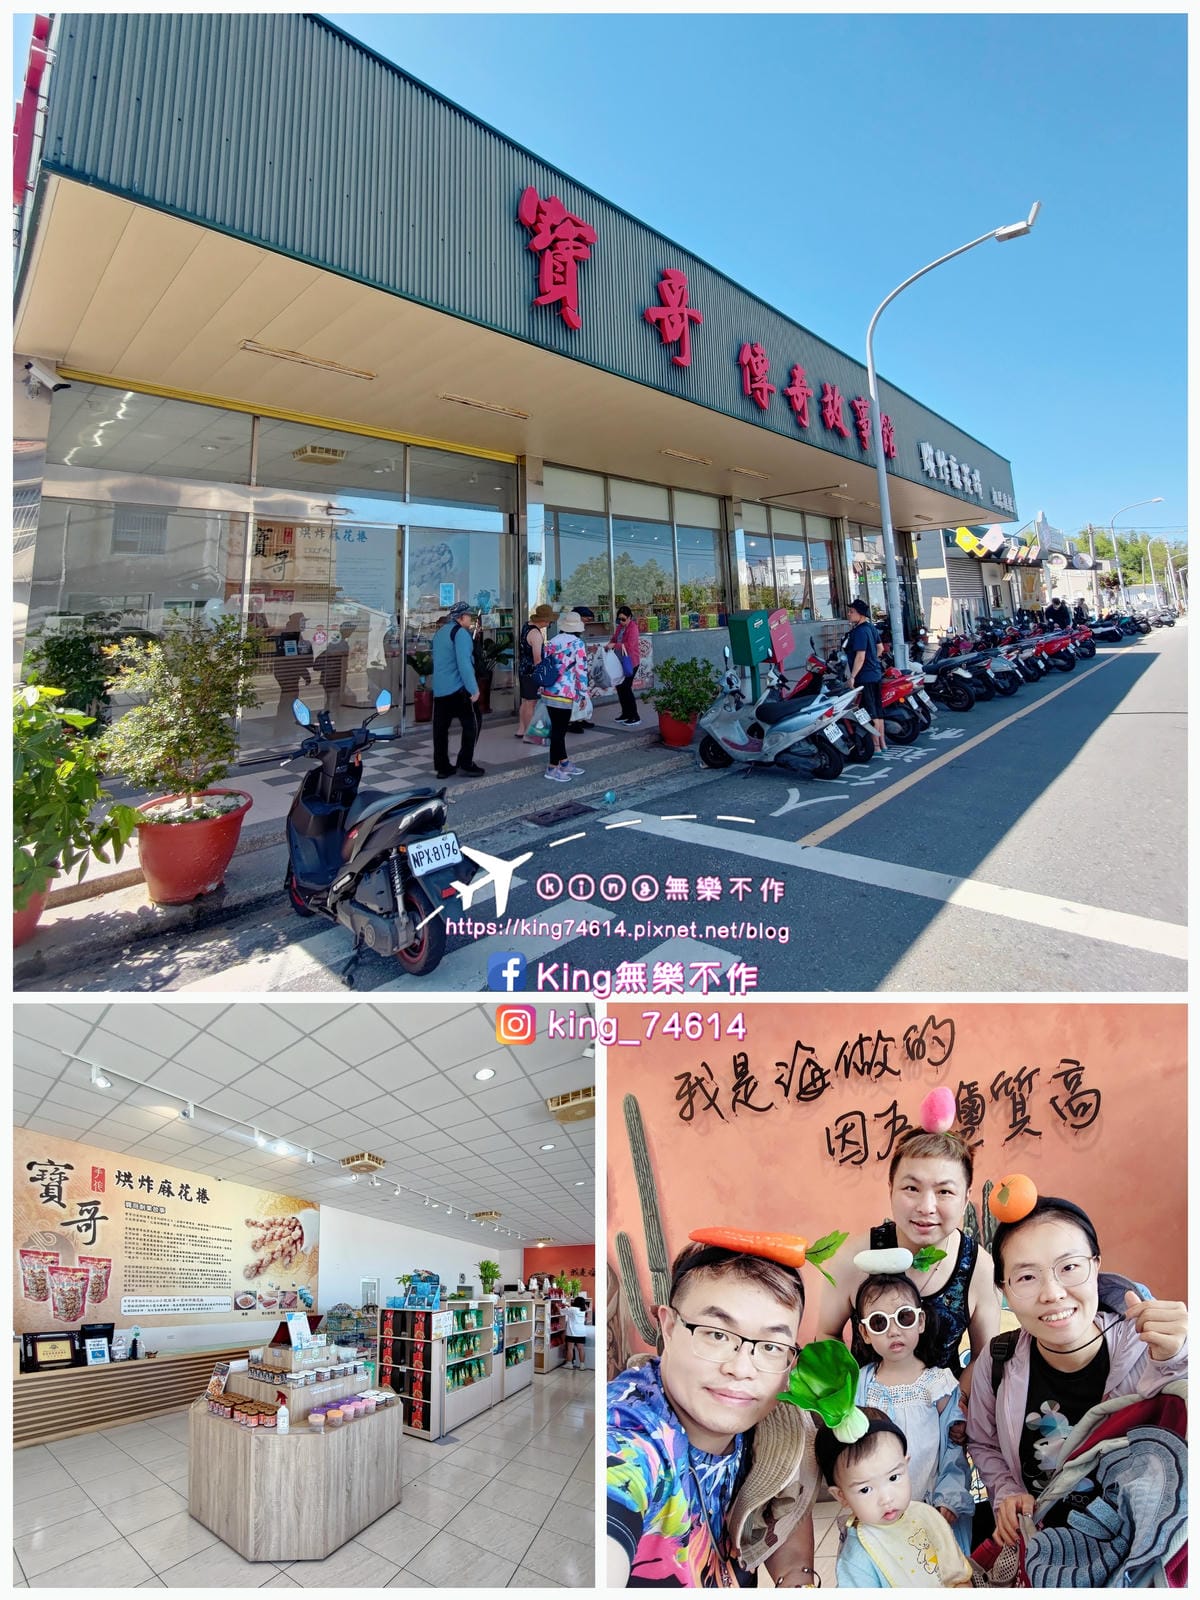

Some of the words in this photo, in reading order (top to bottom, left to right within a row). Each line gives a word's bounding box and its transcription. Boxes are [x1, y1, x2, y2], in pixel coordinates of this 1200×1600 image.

[115, 1169, 211, 1204] 烘炸麻花捲
